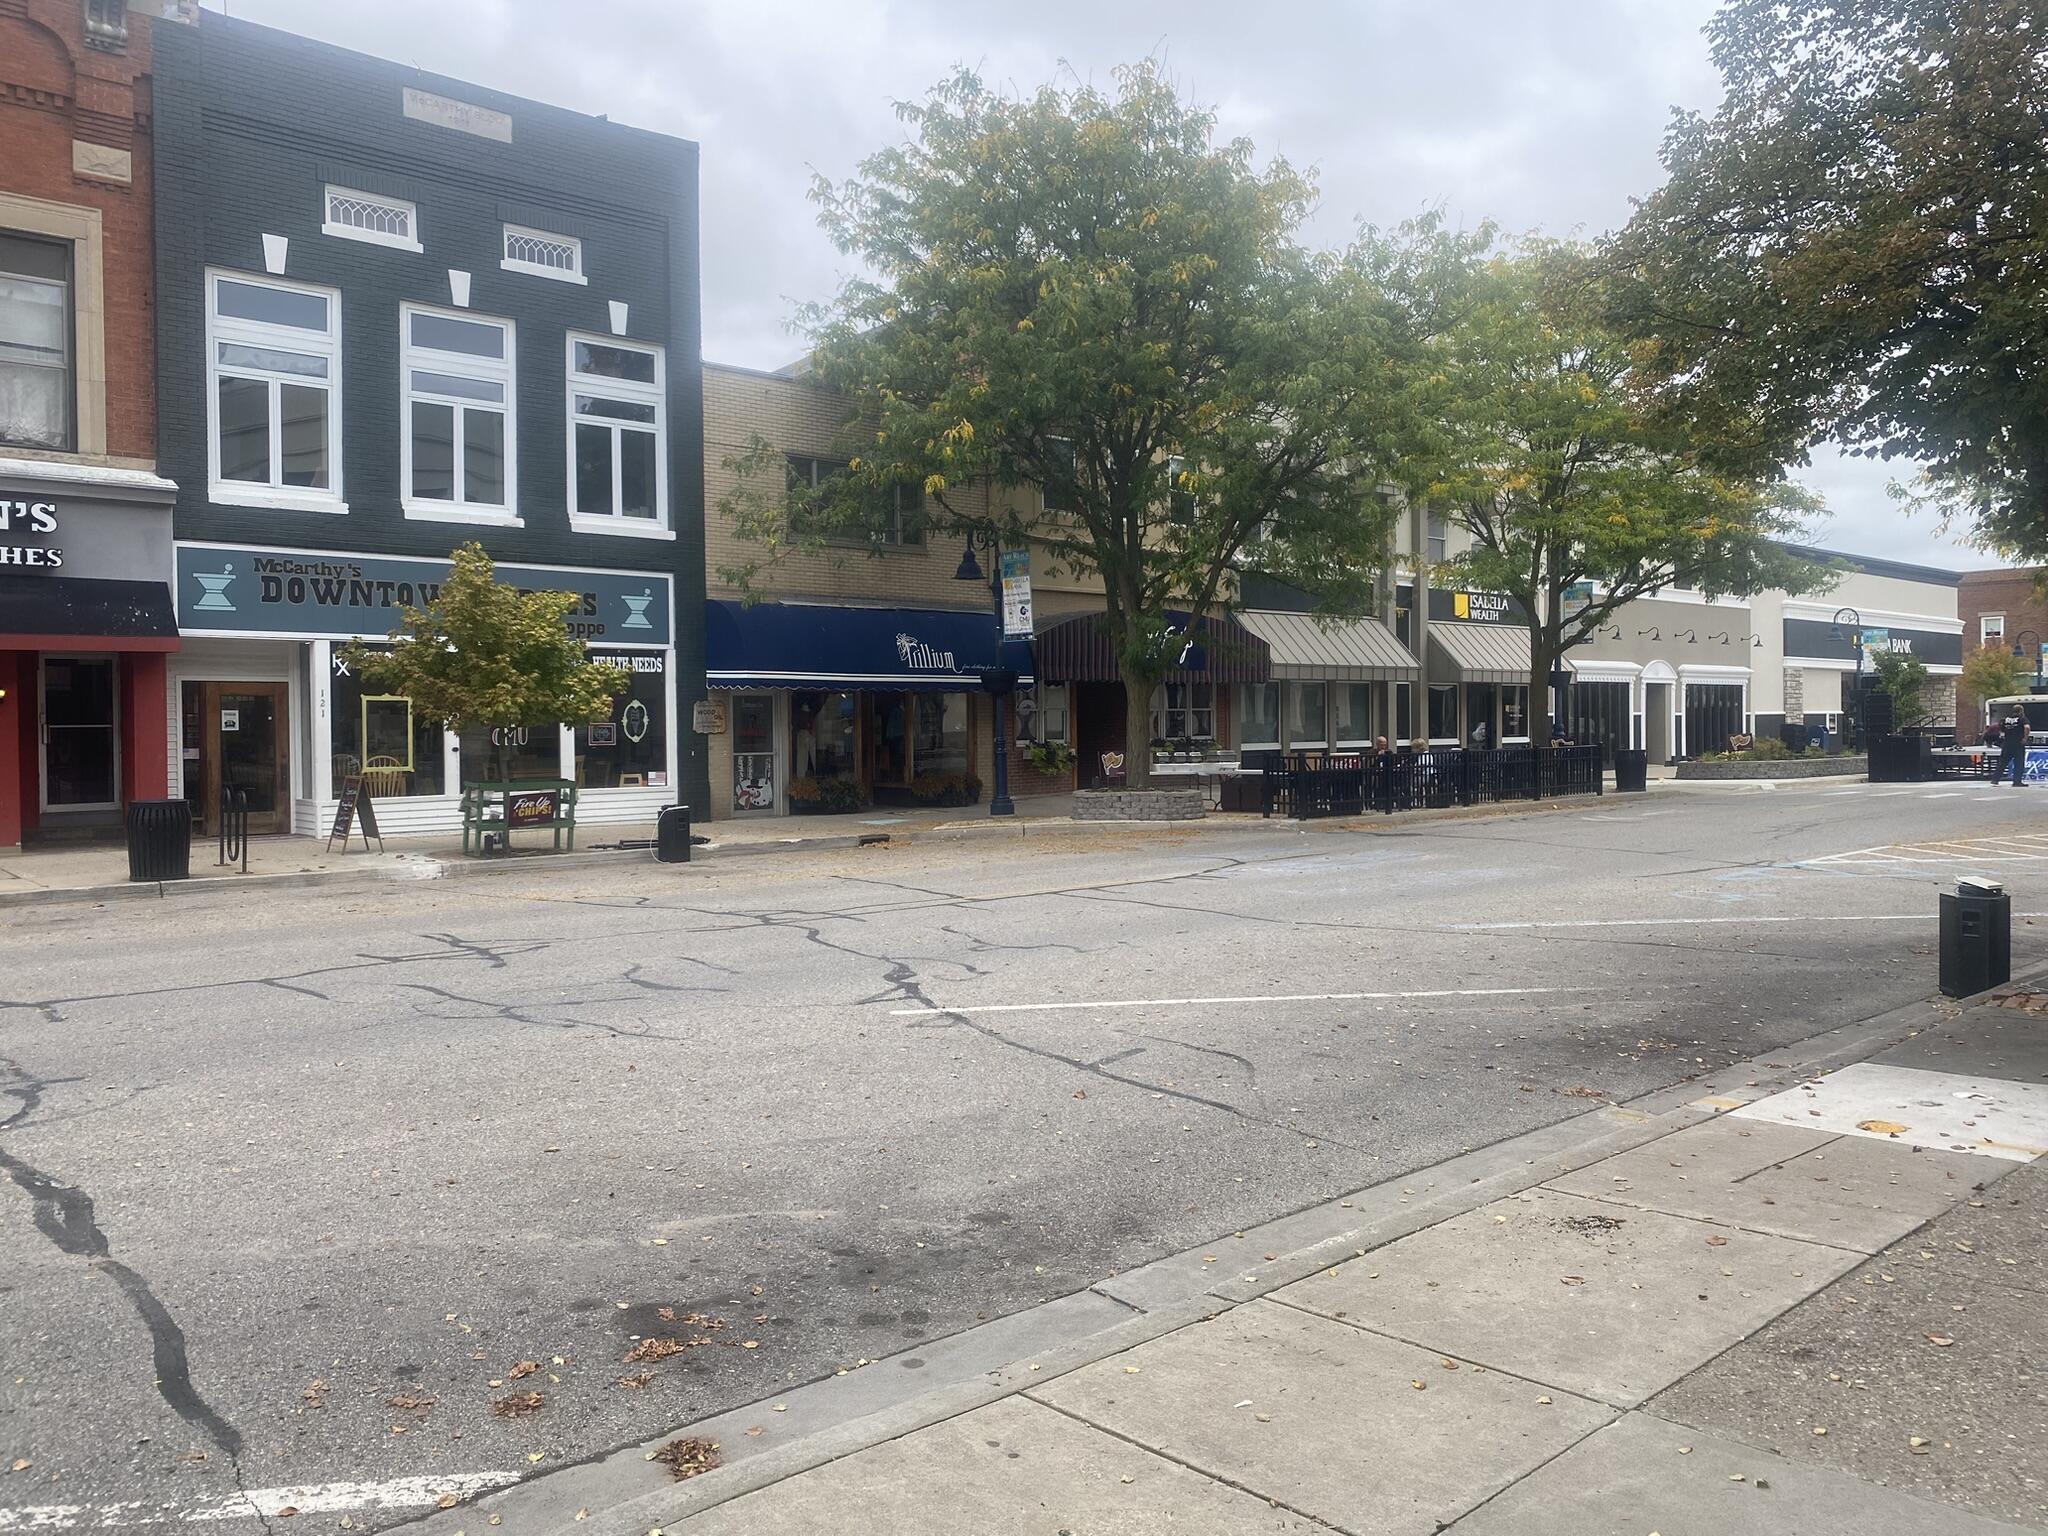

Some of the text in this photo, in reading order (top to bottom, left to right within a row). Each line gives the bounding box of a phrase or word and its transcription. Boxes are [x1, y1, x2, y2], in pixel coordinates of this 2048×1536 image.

[1470, 595, 1509, 611] ISABELLA
[1470, 609, 1499, 621] WEALTH
[1893, 638, 1912, 654] BANK
[632, 656, 663, 673] NEEDS
[904, 643, 963, 674] Trillium
[513, 796, 552, 810] Fire Up
